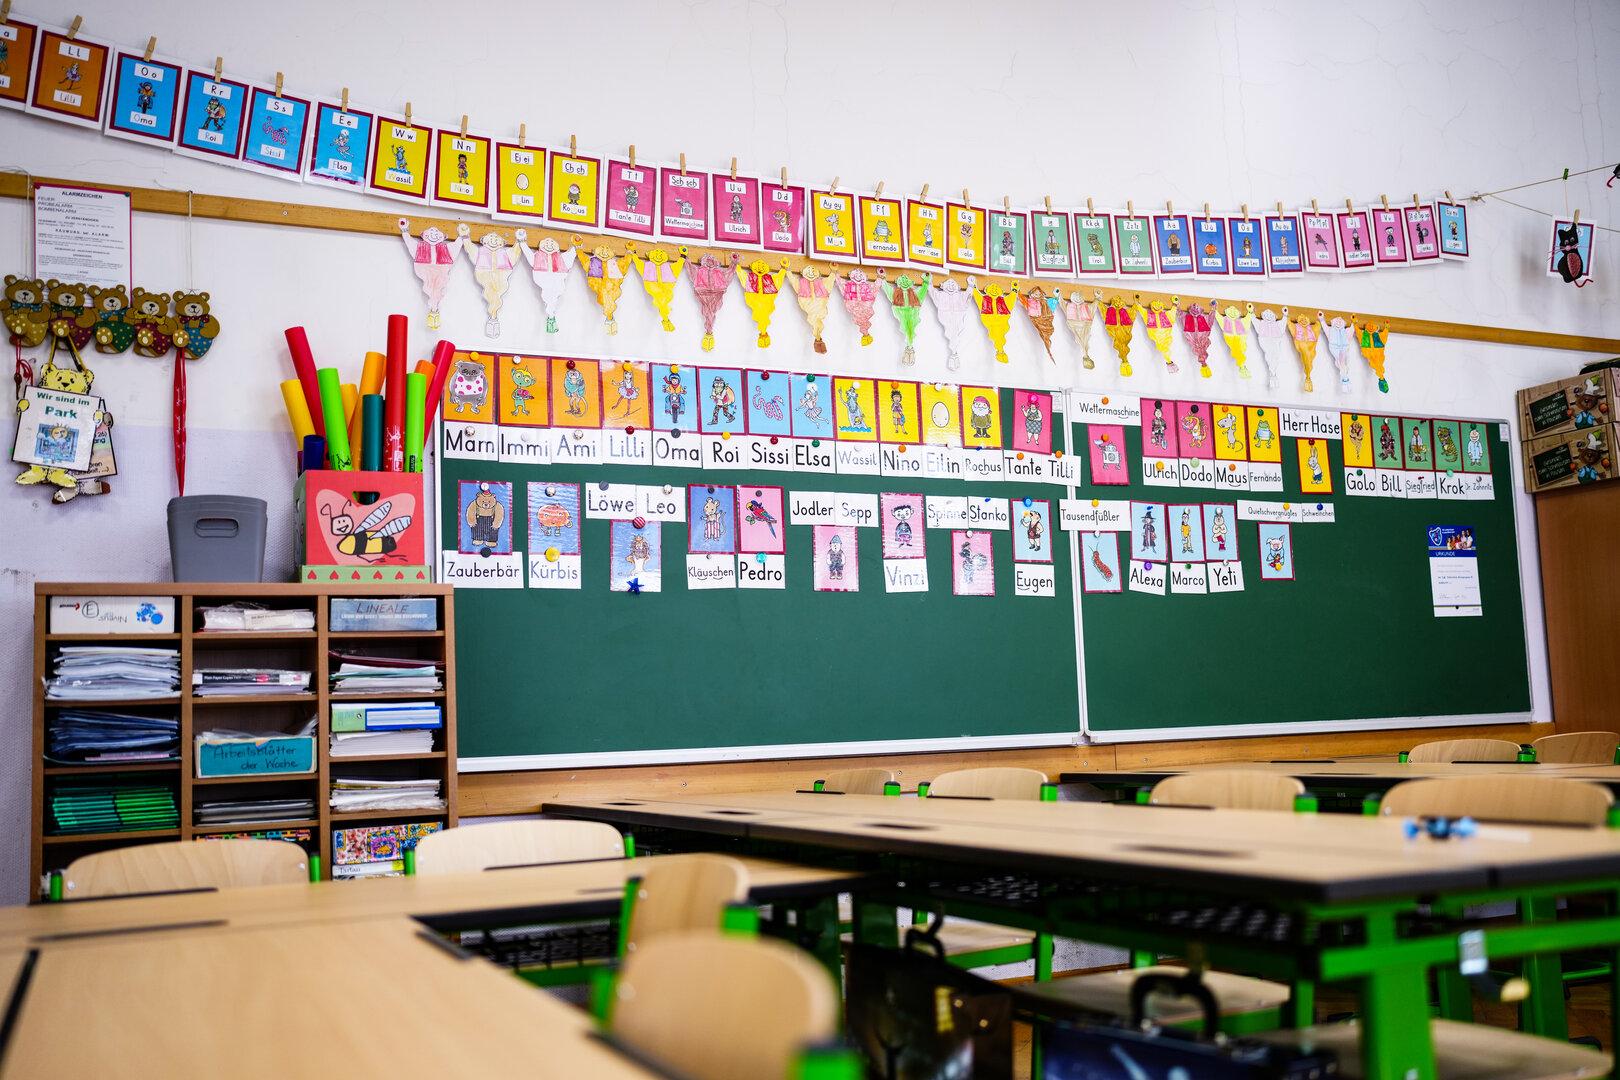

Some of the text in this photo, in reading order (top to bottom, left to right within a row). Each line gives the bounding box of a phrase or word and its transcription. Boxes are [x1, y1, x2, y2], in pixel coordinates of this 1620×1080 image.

[133, 113, 153, 125] Oma
[205, 132, 216, 142] Roi
[265, 146, 281, 158] Sissi
[332, 160, 348, 171] Elsa
[671, 176, 697, 188] Sch sch
[61, 191, 103, 199] ALARMZEICHEN
[562, 203, 585, 214] Rous
[665, 218, 703, 229] Wettermaine
[728, 223, 747, 232] Ulrich
[775, 234, 790, 242] Dodo
[827, 237, 843, 246] Ms
[870, 243, 897, 252] ernando
[1165, 257, 1188, 265] Zauberbr
[37, 392, 90, 406] Wir sind im
[45, 405, 77, 419] Park
[1079, 402, 1140, 418] Wettermaschine
[1282, 412, 1340, 434] Herr Hase
[500, 432, 548, 457] Immi
[556, 434, 596, 458] Ami
[609, 434, 645, 459] Lilli
[654, 437, 700, 462] Oma
[712, 441, 739, 464] Roi
[750, 441, 790, 465] Sissi
[795, 443, 831, 466] Elsa
[838, 449, 879, 466] Wassil
[883, 449, 920, 472] Nino
[965, 457, 1002, 474] Rochus
[1004, 456, 1074, 479] Tante Tilli
[1143, 462, 1178, 480] Ulrich
[1181, 463, 1213, 482] Dodo
[1216, 466, 1248, 484] Maus
[1249, 471, 1282, 483] Fernando
[1346, 472, 1376, 491] Golo
[1380, 474, 1402, 493] Bill
[1405, 479, 1436, 494] Siegfried
[1439, 477, 1465, 495] Krok
[588, 489, 676, 515] Löwe Leo
[792, 500, 872, 524] Jodler Sepp
[927, 503, 1007, 526] Spinne Stanko
[1060, 508, 1120, 526] Tausendfüßler
[1301, 508, 1336, 518] Schweinchen
[446, 561, 520, 578] Zauberbär
[530, 560, 578, 580] Kürbis
[688, 565, 734, 579] Kläuschen
[739, 562, 783, 581] Pedro
[885, 564, 926, 586] Vinzi
[1212, 568, 1238, 587] Yeti
[1016, 571, 1054, 593] Eugen
[1130, 570, 1164, 587] Alexa
[1171, 571, 1205, 586] Marco
[356, 602, 410, 614] LINEALE
[241, 759, 299, 770] der Woche
